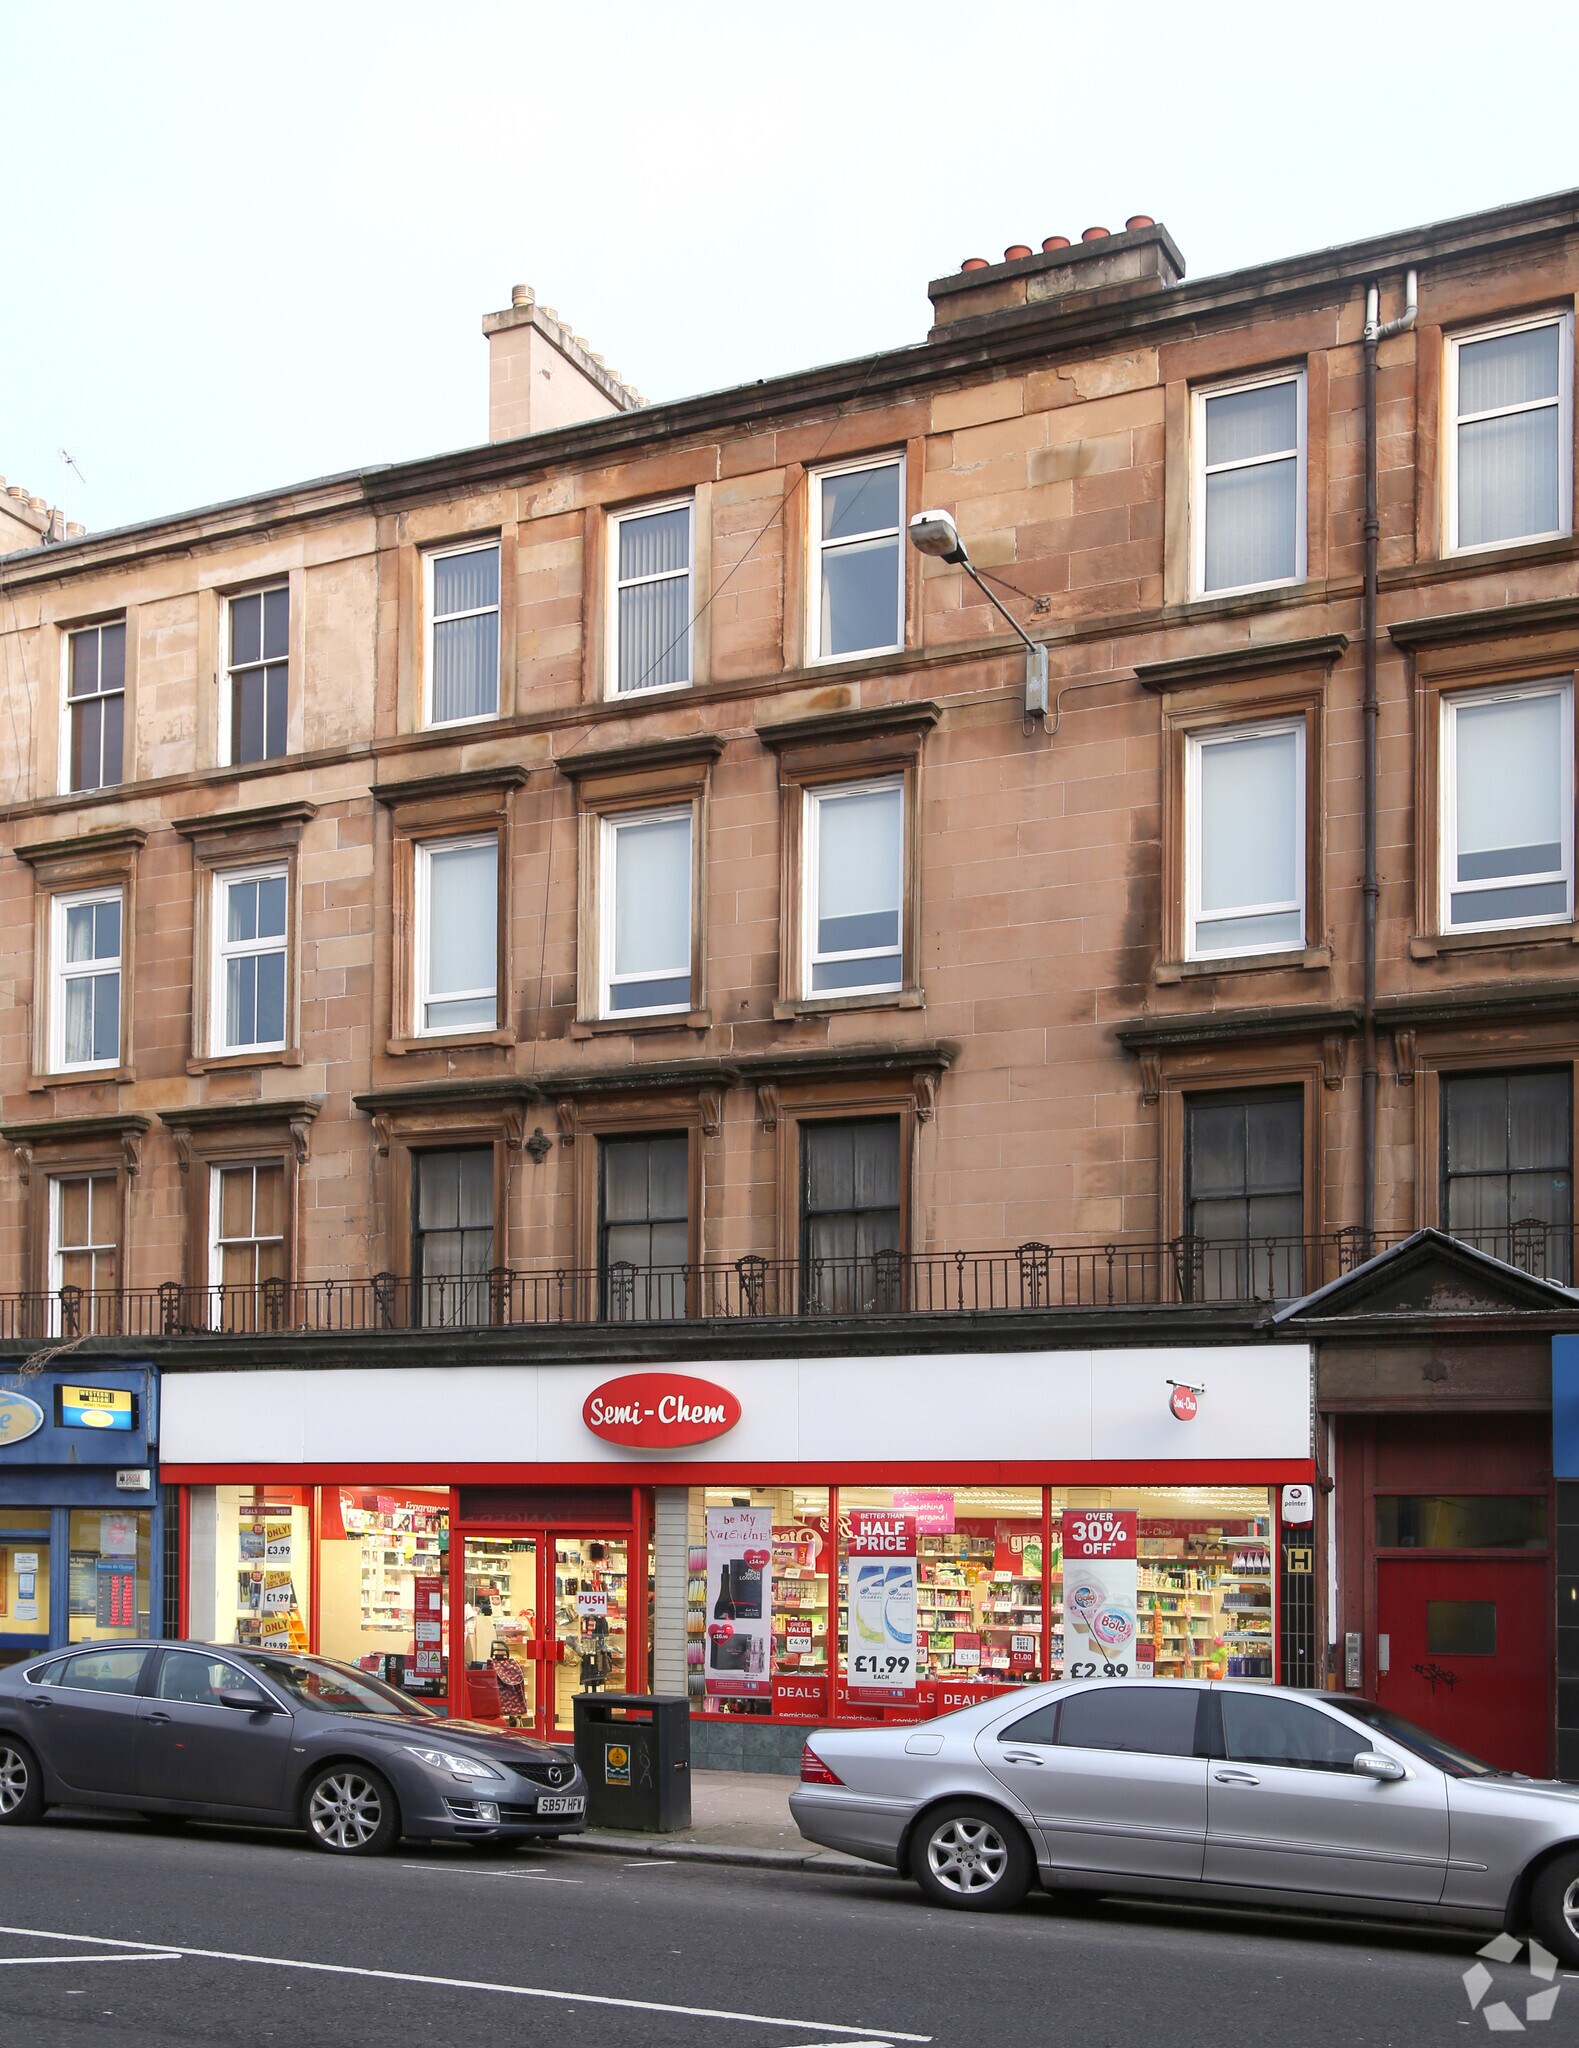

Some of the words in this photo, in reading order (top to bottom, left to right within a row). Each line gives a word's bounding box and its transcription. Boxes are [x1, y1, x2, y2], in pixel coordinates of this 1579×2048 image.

[79, 1390, 109, 1398] WESTERN
[590, 1395, 726, 1426] Semi-Chem
[723, 1515, 735, 1525] be
[740, 1513, 756, 1527] My
[1085, 1513, 1113, 1521] OVER
[267, 1524, 291, 1538] ONLY!
[860, 1521, 905, 1536] HALF
[1072, 1521, 1127, 1542] 30%
[267, 1546, 291, 1555] £3.99
[1290, 1551, 1309, 1570] H
[269, 1572, 285, 1581] OVER
[266, 1593, 289, 1602] £1.99
[578, 1595, 605, 1605] PUSH
[265, 1619, 288, 1633] ONLY
[787, 1626, 811, 1634] VALUE
[1101, 1615, 1127, 1633] Bold
[789, 1638, 809, 1646] £4.99
[854, 1655, 910, 1674] £1.99
[1069, 1662, 1129, 1679] £2.99
[777, 1686, 821, 1698] DEALS
[542, 1799, 567, 1812] SB57
